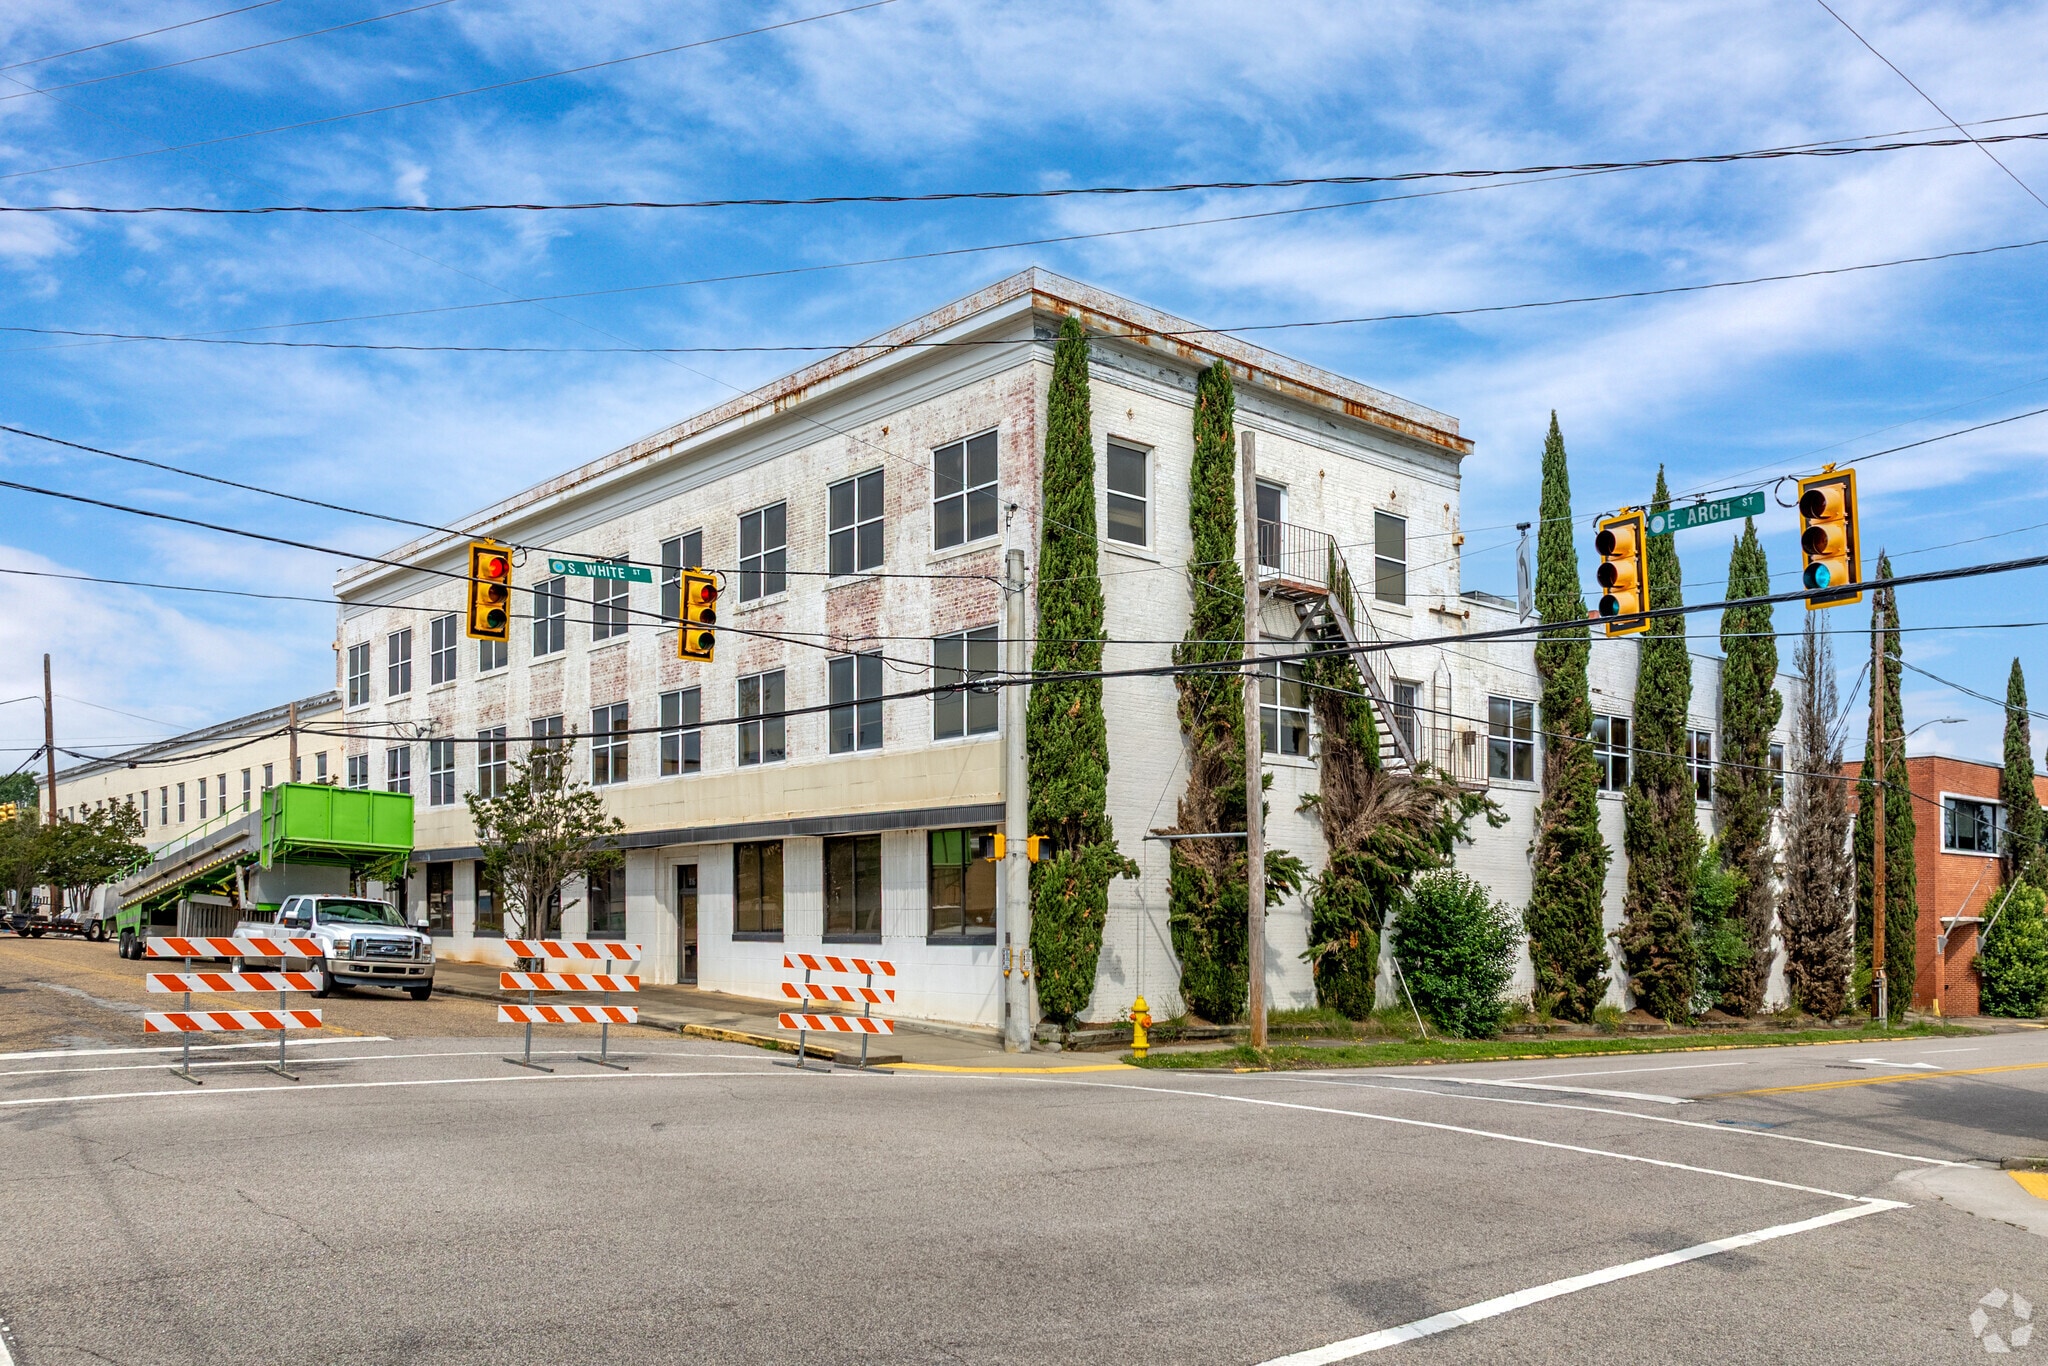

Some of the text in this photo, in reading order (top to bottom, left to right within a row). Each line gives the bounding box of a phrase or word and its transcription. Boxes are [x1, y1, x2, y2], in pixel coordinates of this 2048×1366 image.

[1667, 497, 1754, 529] E. ARCH ST
[568, 562, 580, 574] S.
[585, 564, 625, 578] WHITE
